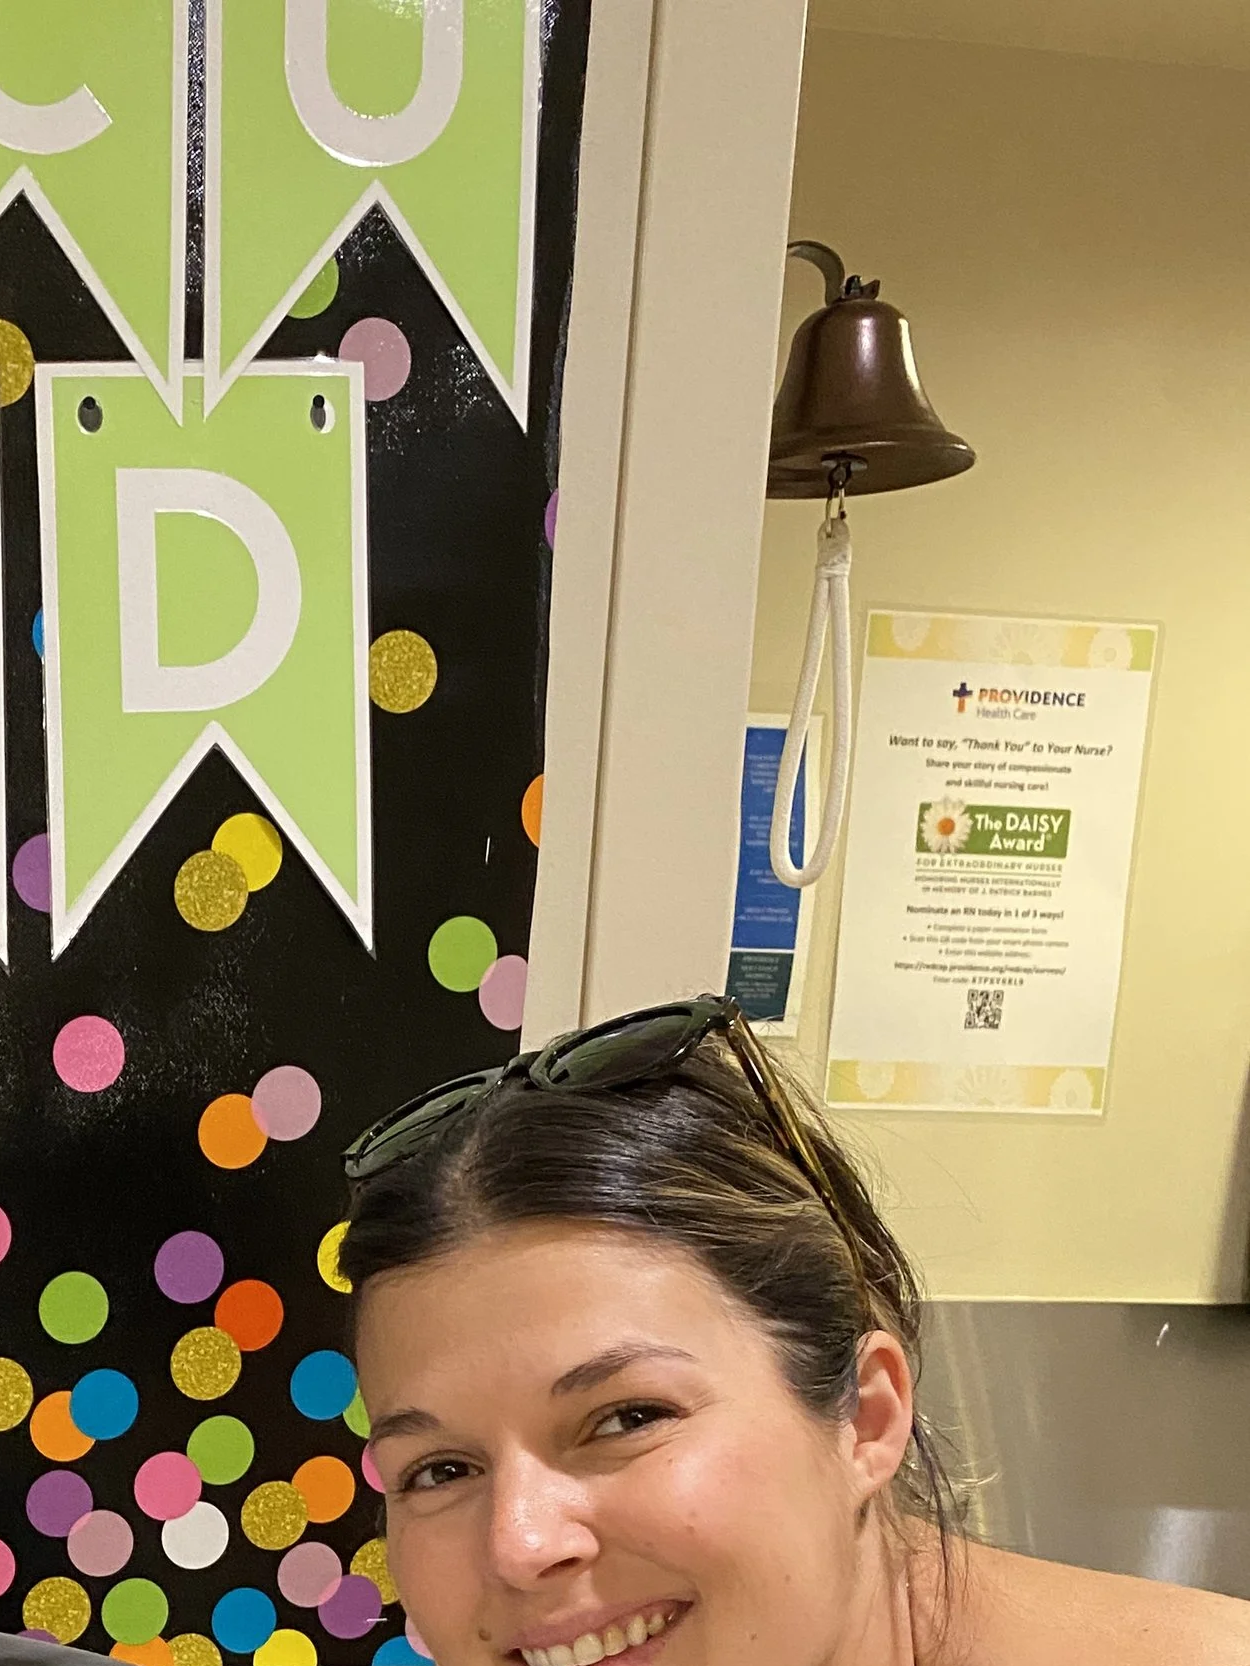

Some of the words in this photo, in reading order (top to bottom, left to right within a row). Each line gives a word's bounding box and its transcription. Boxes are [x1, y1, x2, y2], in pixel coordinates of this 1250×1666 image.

[978, 688, 1086, 707] PROVIDENCE
[976, 707, 1011, 719] Health
[1013, 709, 1037, 720] Care
[889, 735, 919, 747] Want
[922, 737, 934, 747] to
[936, 738, 958, 750] say,
[1033, 743, 1044, 753] to
[1047, 742, 1071, 755] Your
[1074, 745, 1113, 757] Nurse?
[926, 758, 950, 768] Share
[952, 761, 971, 771] your
[974, 761, 995, 772] story
[997, 761, 1006, 771] of
[1008, 763, 1072, 774] compassionate
[946, 778, 962, 788] and
[994, 780, 1025, 791] nursing
[1027, 781, 1049, 791] care!
[975, 814, 1003, 831] The
[1006, 812, 1064, 833] DAISY
[916, 857, 937, 867] FOR
[940, 858, 1023, 870] EXTRAORDINARY
[906, 905, 948, 915] Nominate
[951, 907, 961, 915] an
[963, 907, 976, 916] RN
[978, 907, 1002, 919] today
[1004, 907, 1012, 917] in
[1021, 908, 1031, 918] of
